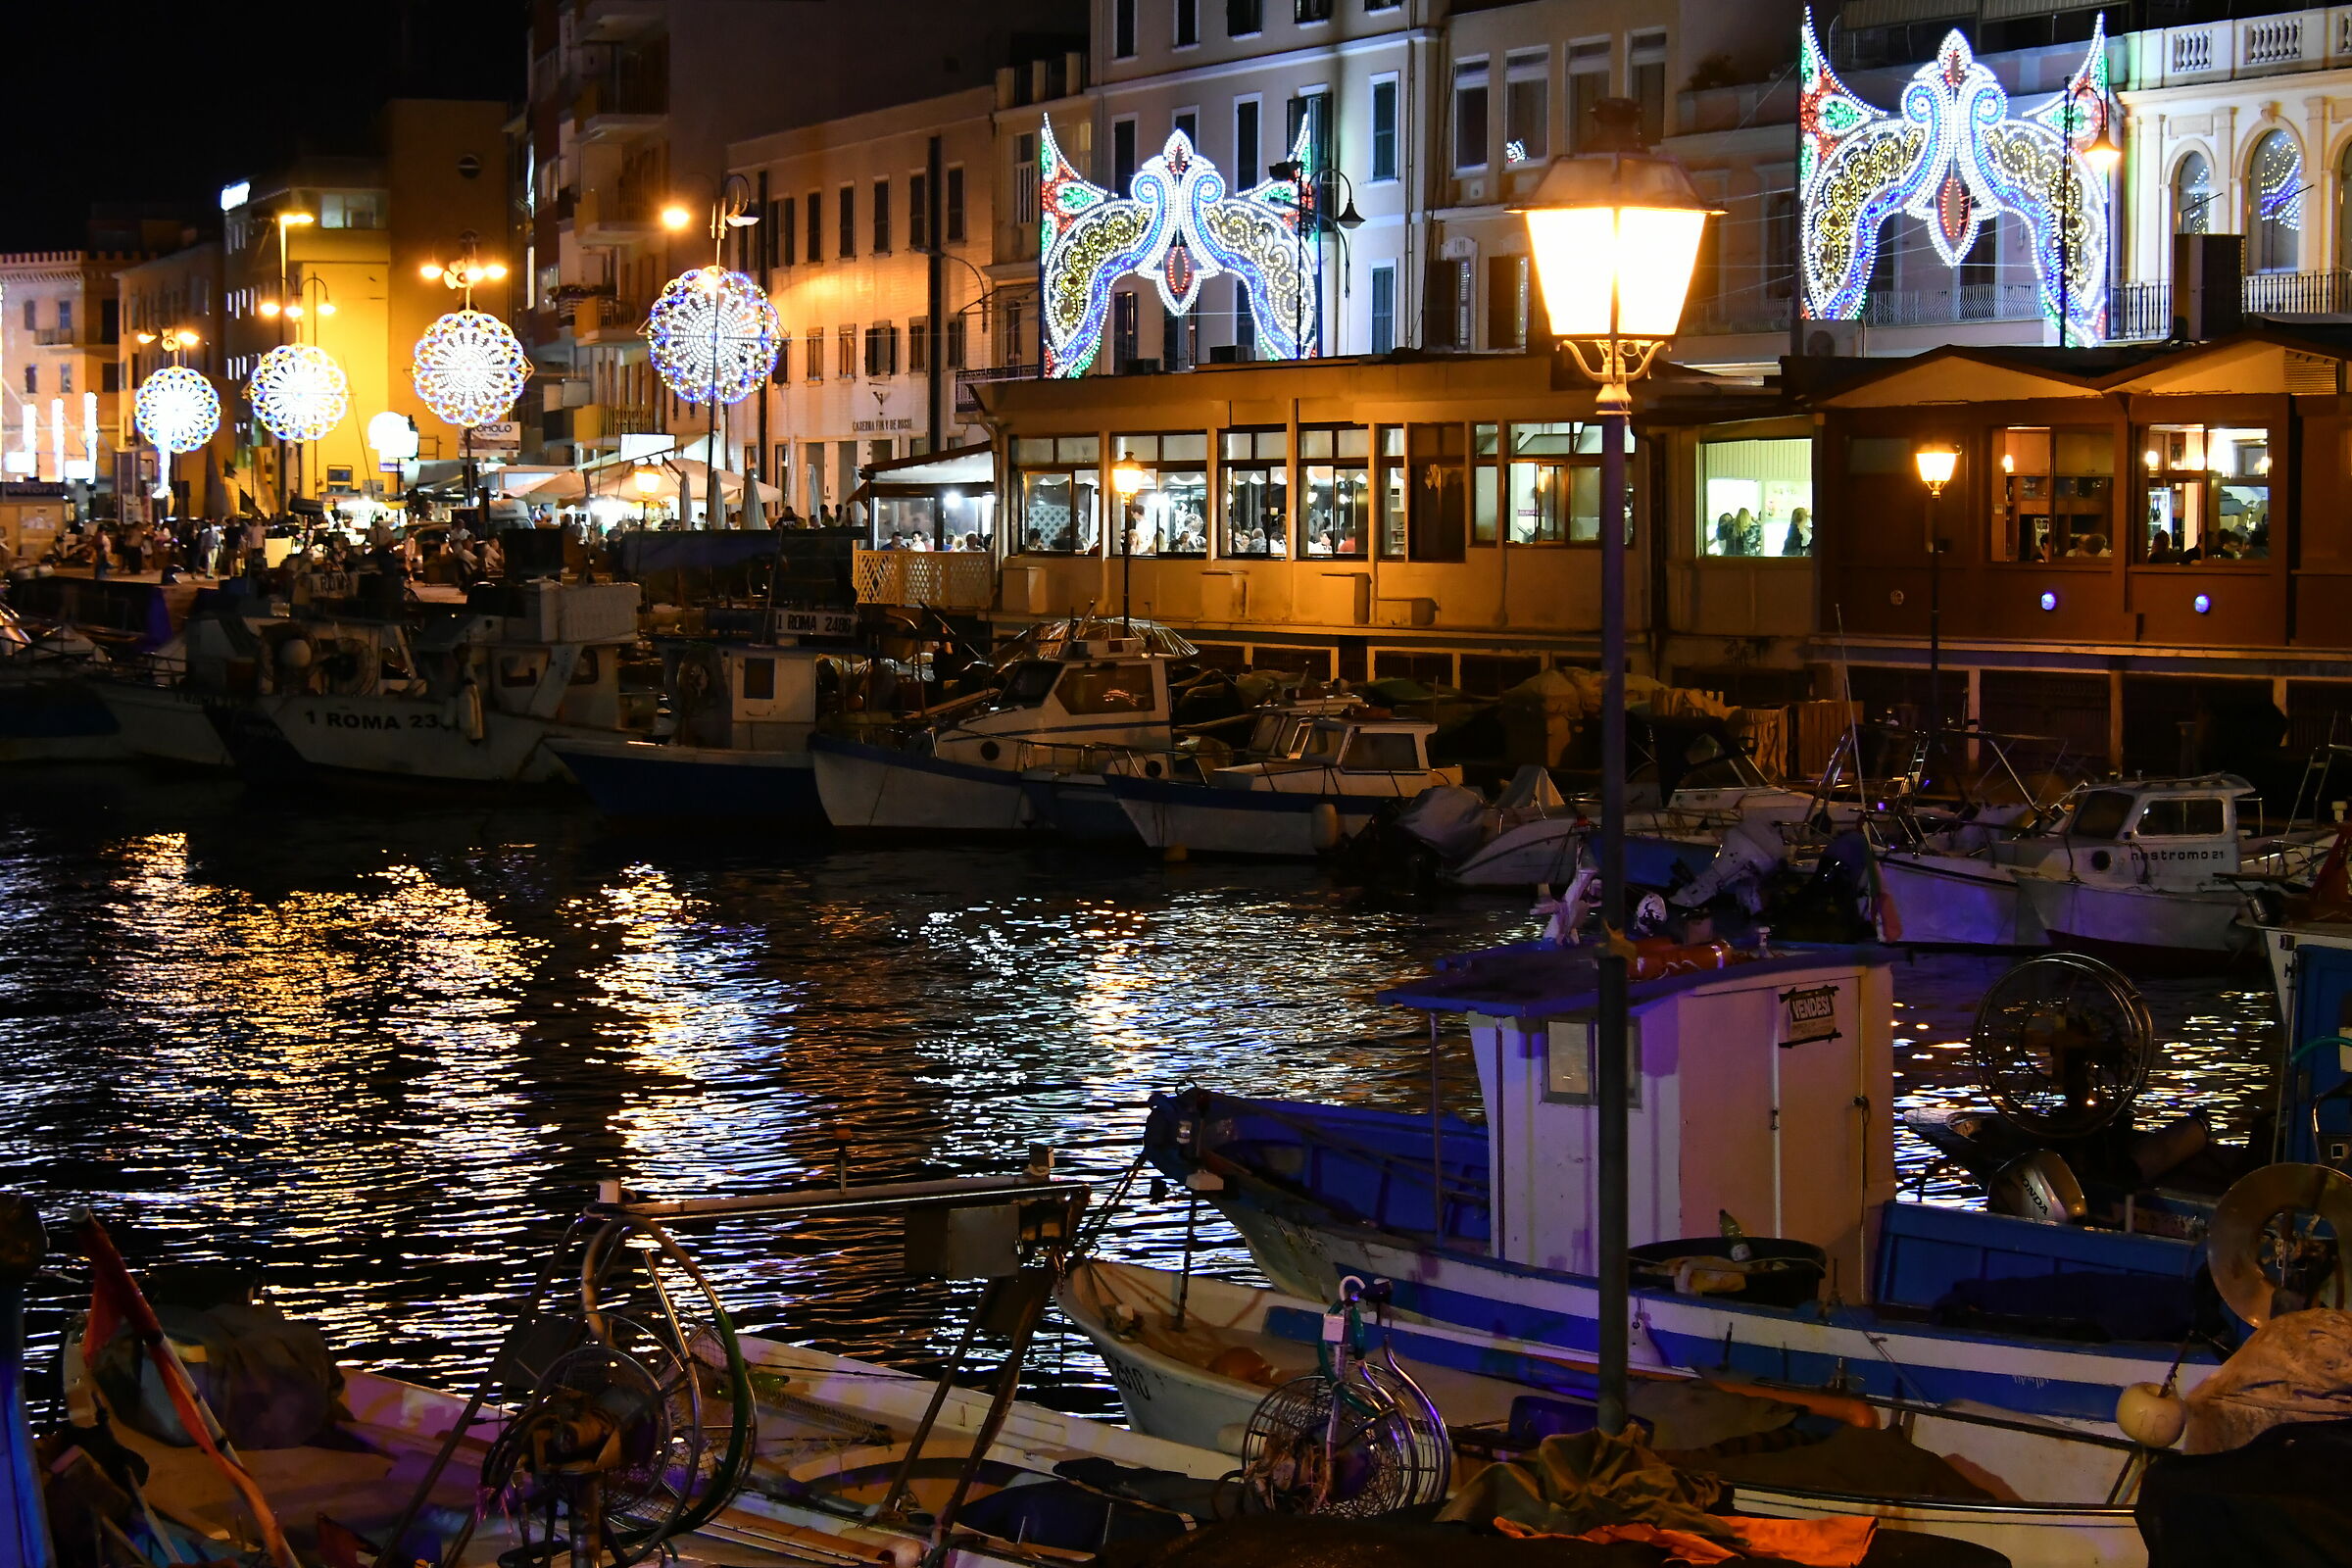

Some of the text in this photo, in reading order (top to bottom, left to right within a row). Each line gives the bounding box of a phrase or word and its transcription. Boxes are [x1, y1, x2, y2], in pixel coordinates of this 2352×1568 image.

[787, 614, 816, 631] ROMA
[305, 710, 315, 724] 1
[326, 712, 401, 730] ROMA
